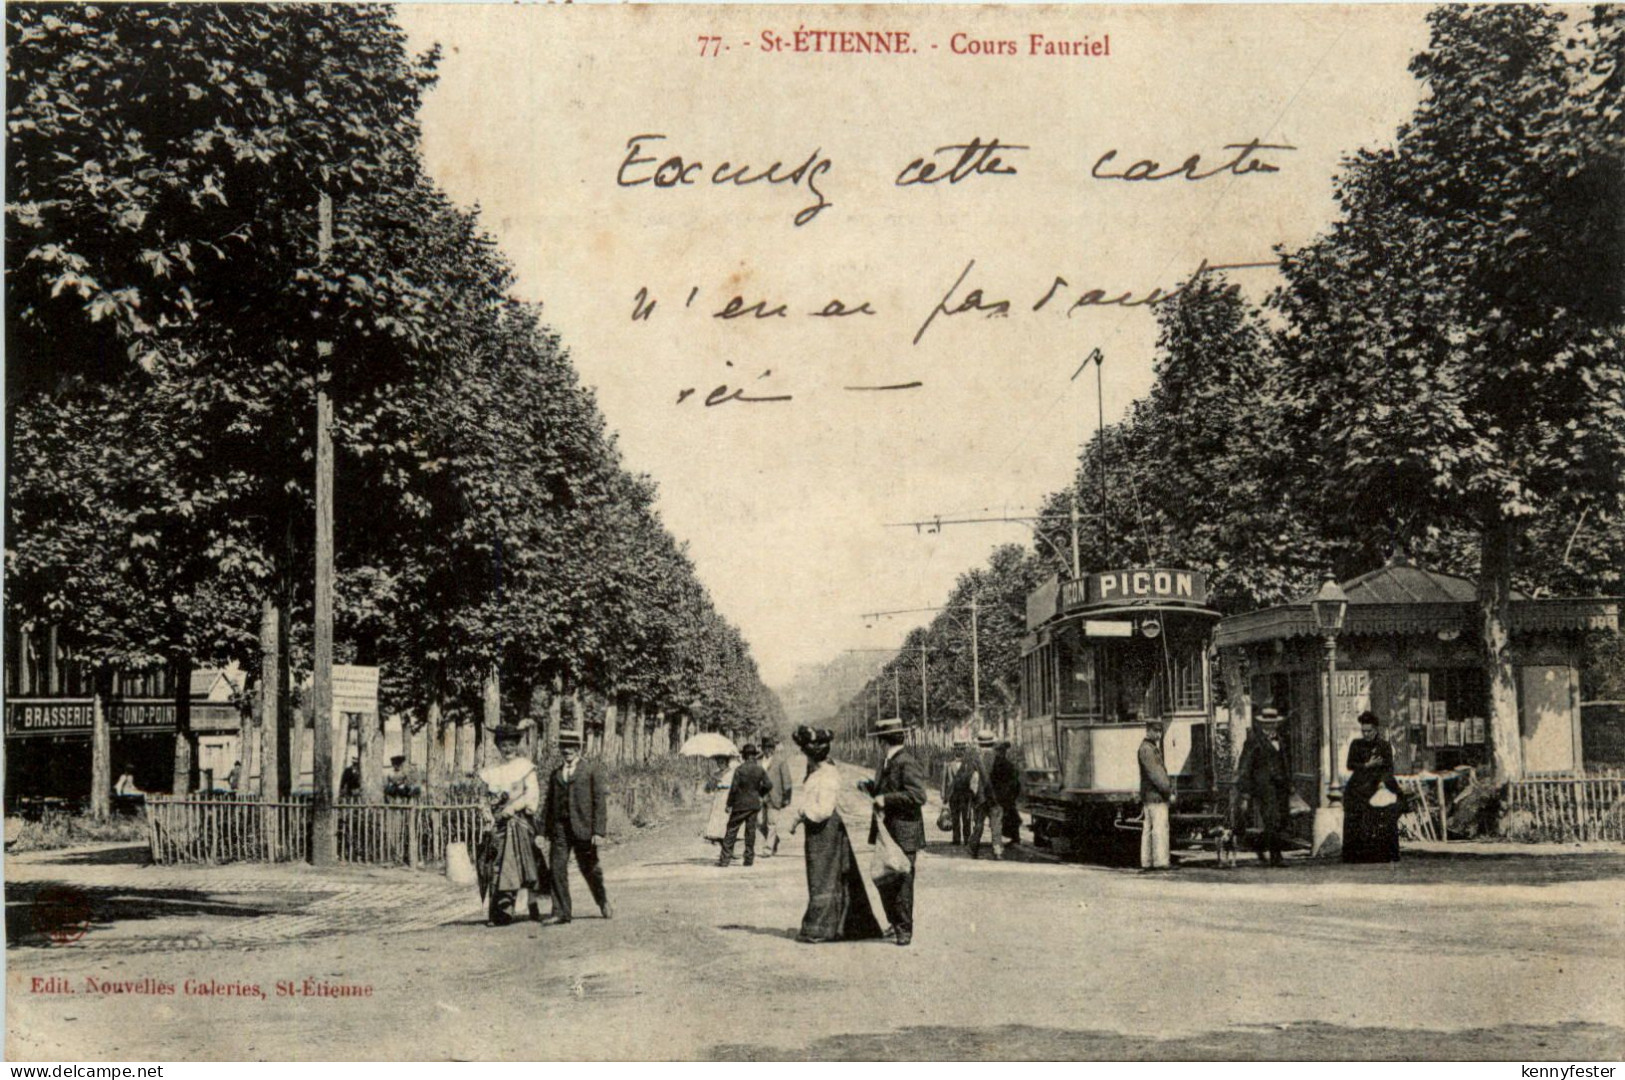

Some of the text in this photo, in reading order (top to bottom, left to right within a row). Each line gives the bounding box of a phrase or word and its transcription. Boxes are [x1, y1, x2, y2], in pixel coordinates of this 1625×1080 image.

[697, 35, 730, 56] 77.
[760, 25, 917, 54] St-ÉTIENNE.
[950, 32, 1018, 55] Cours
[1029, 34, 1111, 56] Fauriel
[896, 137, 1030, 186] cette
[1092, 138, 1297, 181] carte
[1100, 572, 1193, 599] PICON
[24, 706, 94, 728] BRASSERIE
[31, 976, 374, 999] Edit. Nouvelles Galeries, St-Étienne
